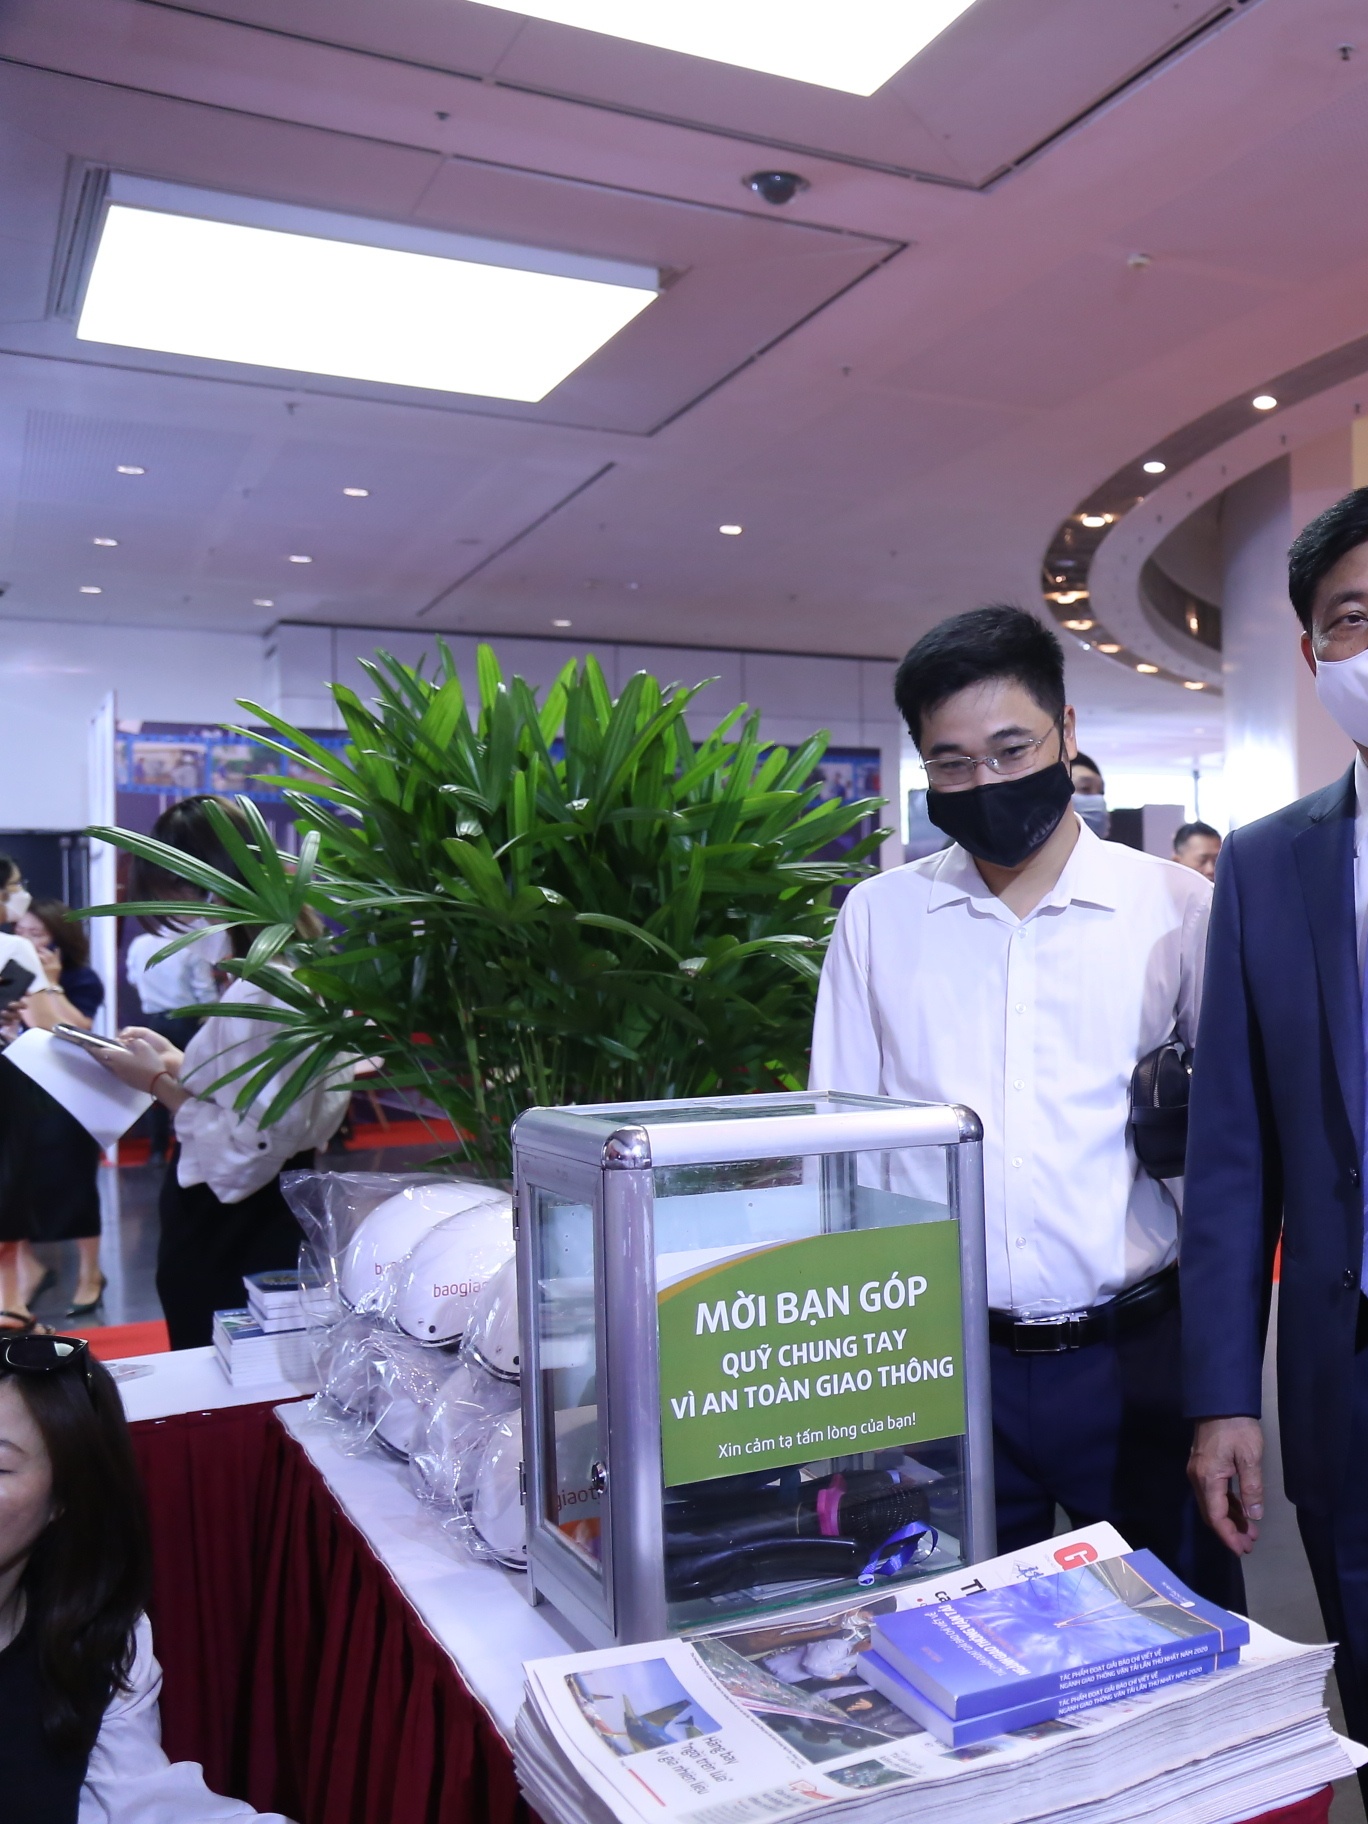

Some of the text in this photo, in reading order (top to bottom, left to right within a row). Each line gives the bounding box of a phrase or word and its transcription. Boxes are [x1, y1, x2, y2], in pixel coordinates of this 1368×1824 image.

[433, 1279, 489, 1298] baogia
[695, 1271, 928, 1335] MỜI BẠN GÓP
[721, 1328, 907, 1379] QUỸ CHUNG TAY
[670, 1356, 954, 1420] VÌ AN TOÀN GIAO THÔNG
[718, 1411, 917, 1459] Xin cảm tạ tấm lòng của bạn!
[1194, 1645, 1209, 1655] 2020
